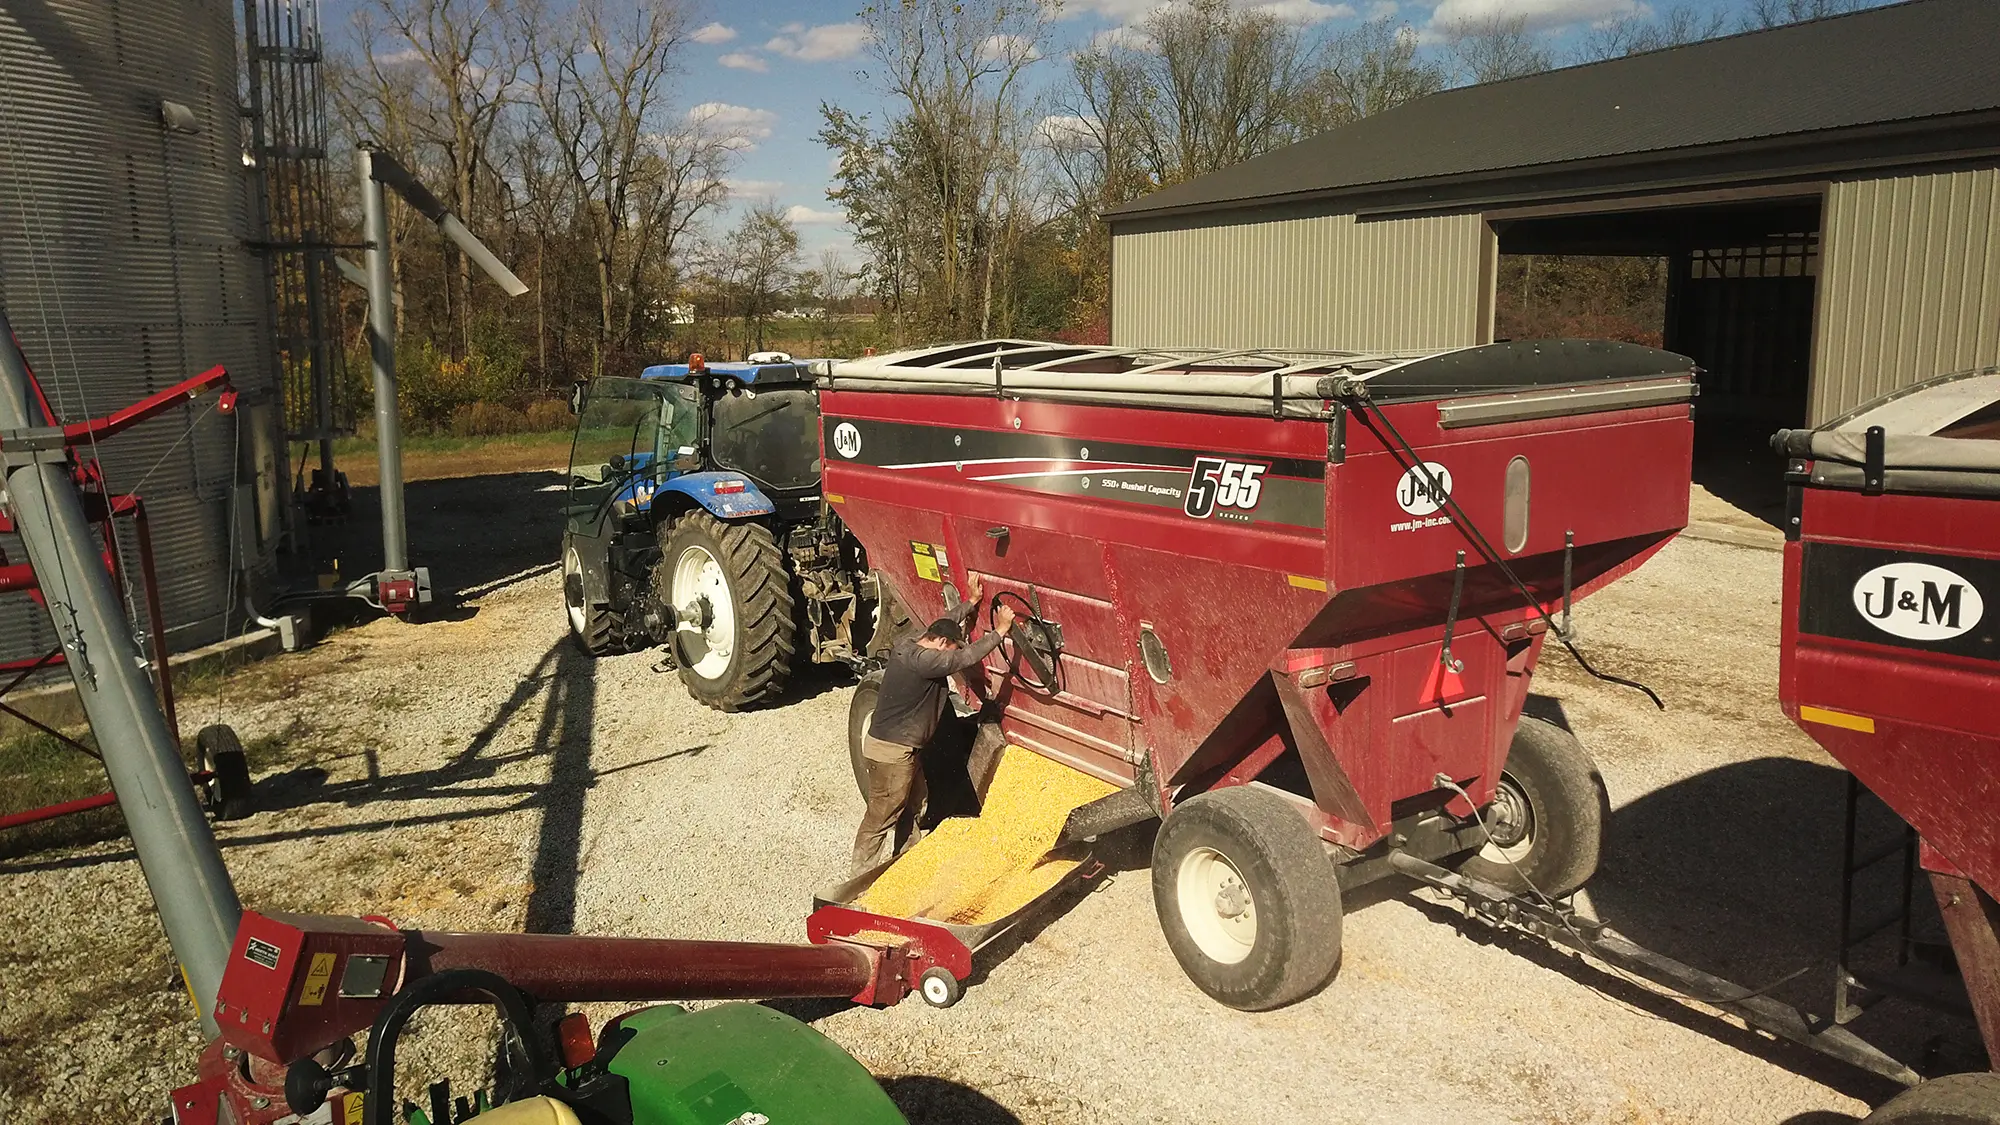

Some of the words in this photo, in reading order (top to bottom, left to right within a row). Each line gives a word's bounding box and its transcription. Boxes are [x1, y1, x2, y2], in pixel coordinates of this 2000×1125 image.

[836, 430, 857, 452] J&M
[1101, 479, 1119, 489] 550+
[1121, 481, 1146, 492] Bushel
[1147, 485, 1181, 498] Capacity
[1184, 457, 1266, 519] 555
[1401, 472, 1444, 507] J&M
[1863, 576, 1965, 629] J&M
